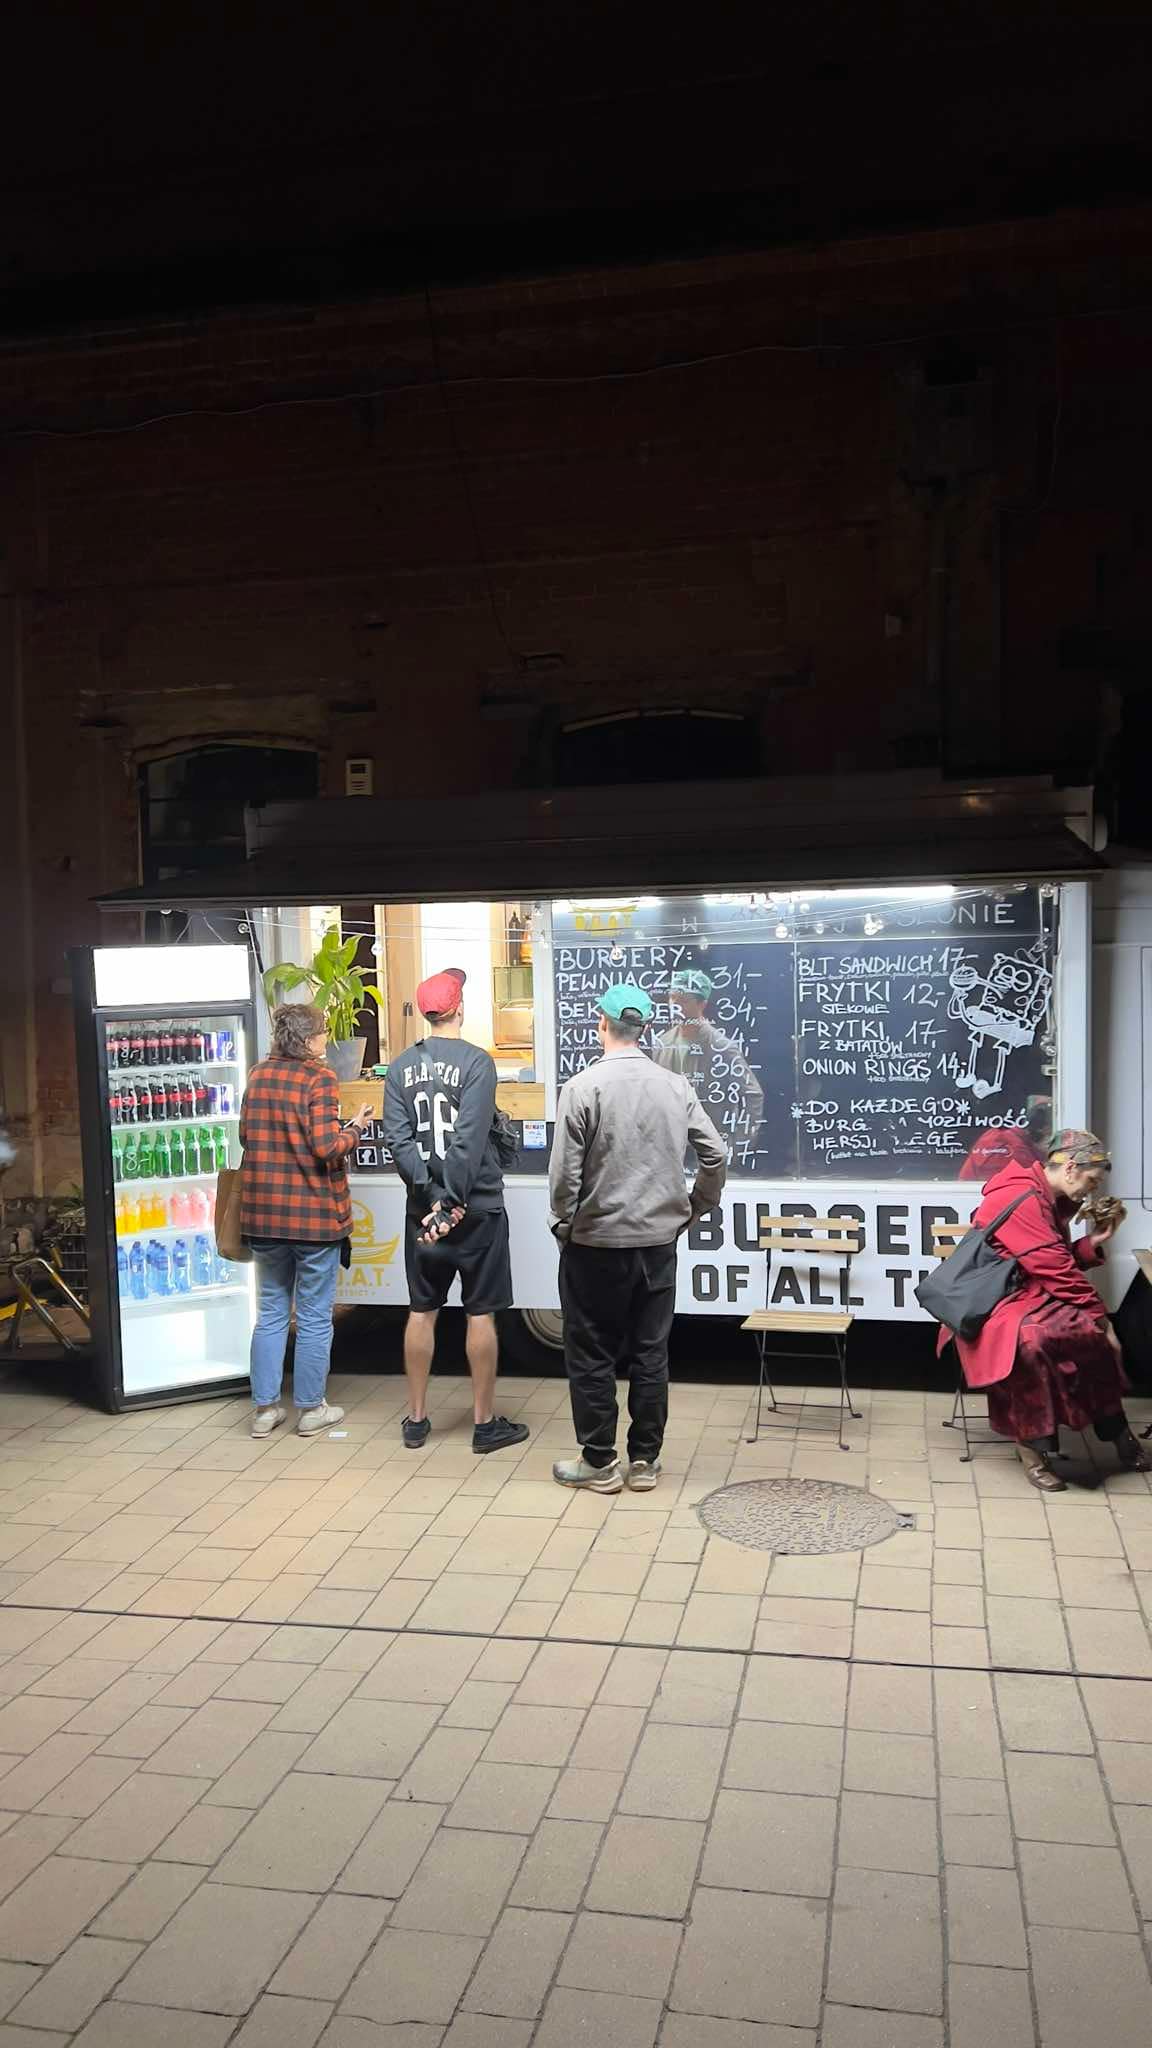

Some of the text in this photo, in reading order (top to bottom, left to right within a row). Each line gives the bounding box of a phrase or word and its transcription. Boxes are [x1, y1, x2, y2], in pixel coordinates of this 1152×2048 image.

[798, 957, 835, 977] BLT
[838, 953, 934, 976] SANDWICH
[799, 980, 891, 1004] FRYTKI
[821, 1003, 890, 1015] STEKOWE
[801, 1019, 886, 1041] FRYTKI
[818, 1040, 831, 1050] Z
[802, 1058, 857, 1076] ONION
[864, 1058, 932, 1080] RINGS
[691, 1264, 751, 1303] OF
[771, 1266, 865, 1307] ALL
